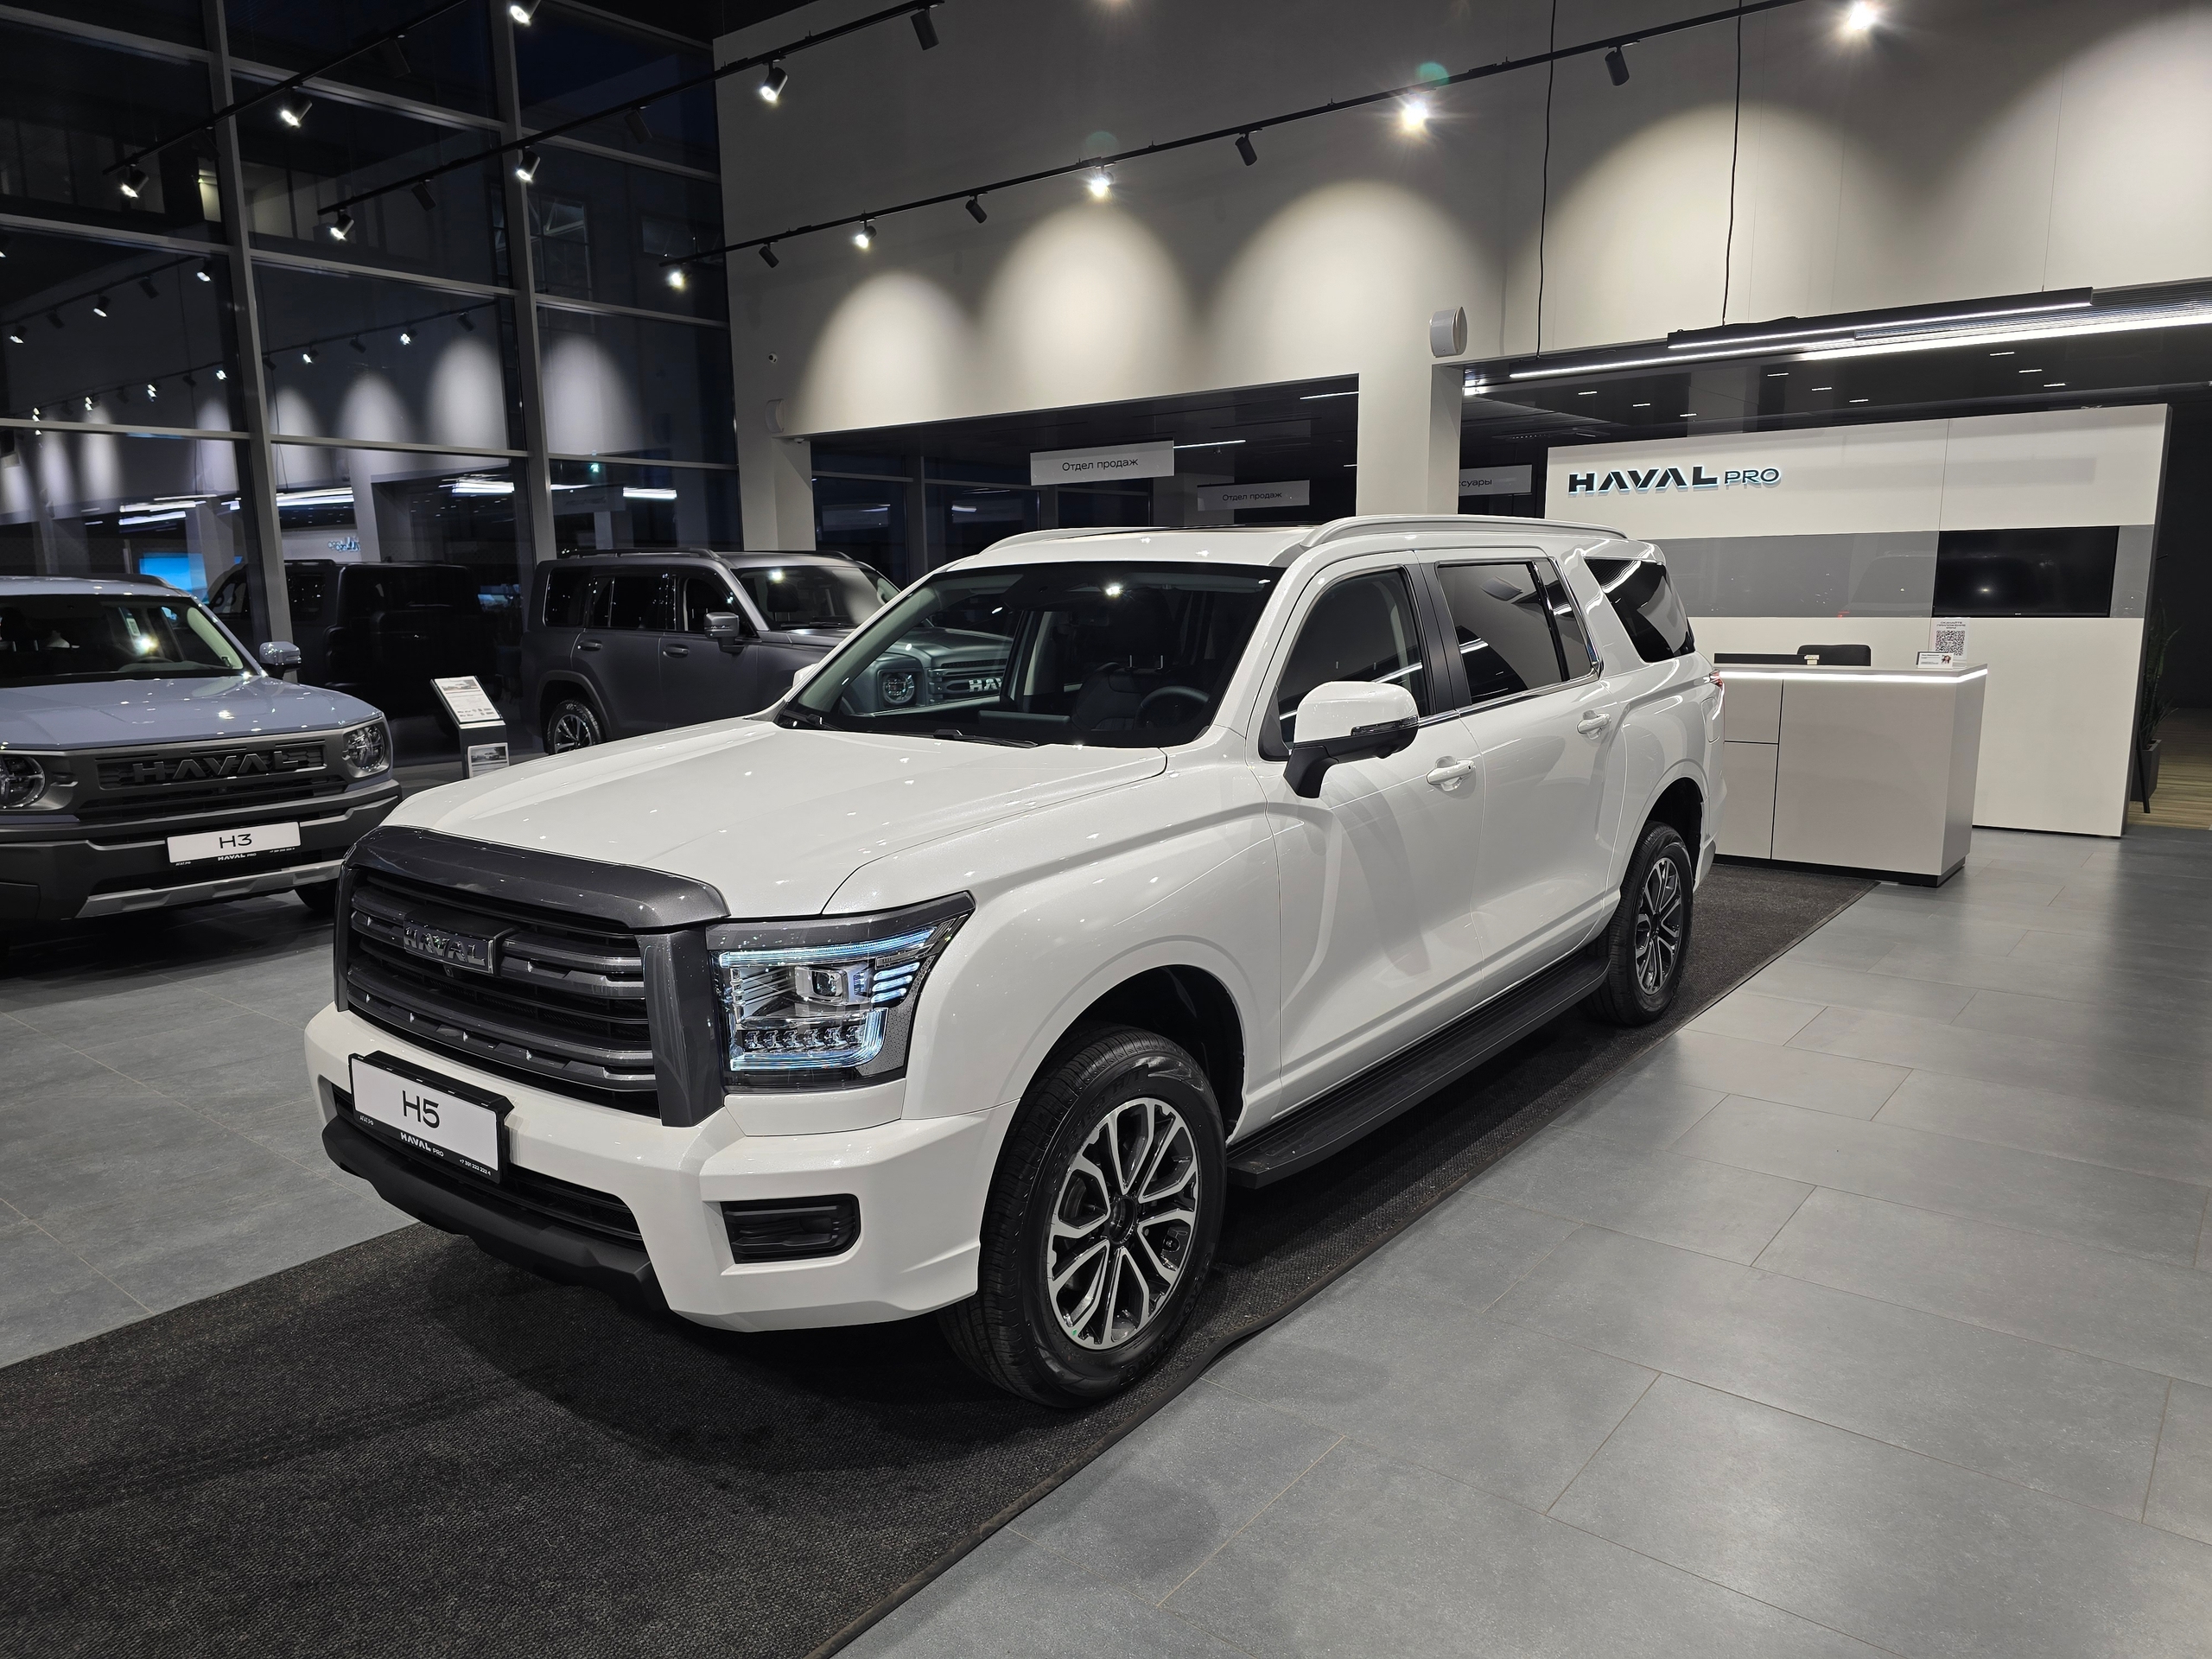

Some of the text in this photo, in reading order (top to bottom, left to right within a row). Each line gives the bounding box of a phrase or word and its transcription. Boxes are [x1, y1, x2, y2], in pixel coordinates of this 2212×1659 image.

[1062, 458, 1139, 472] Отдел продаж
[1567, 466, 1780, 493] HAVAL PRO
[1249, 492, 1282, 500] продаж
[132, 751, 299, 783] HAVAL
[219, 833, 252, 849] H3
[404, 926, 486, 967] HAVAL
[402, 1090, 441, 1128] H5
[400, 1132, 444, 1157] HAVAL PRO
